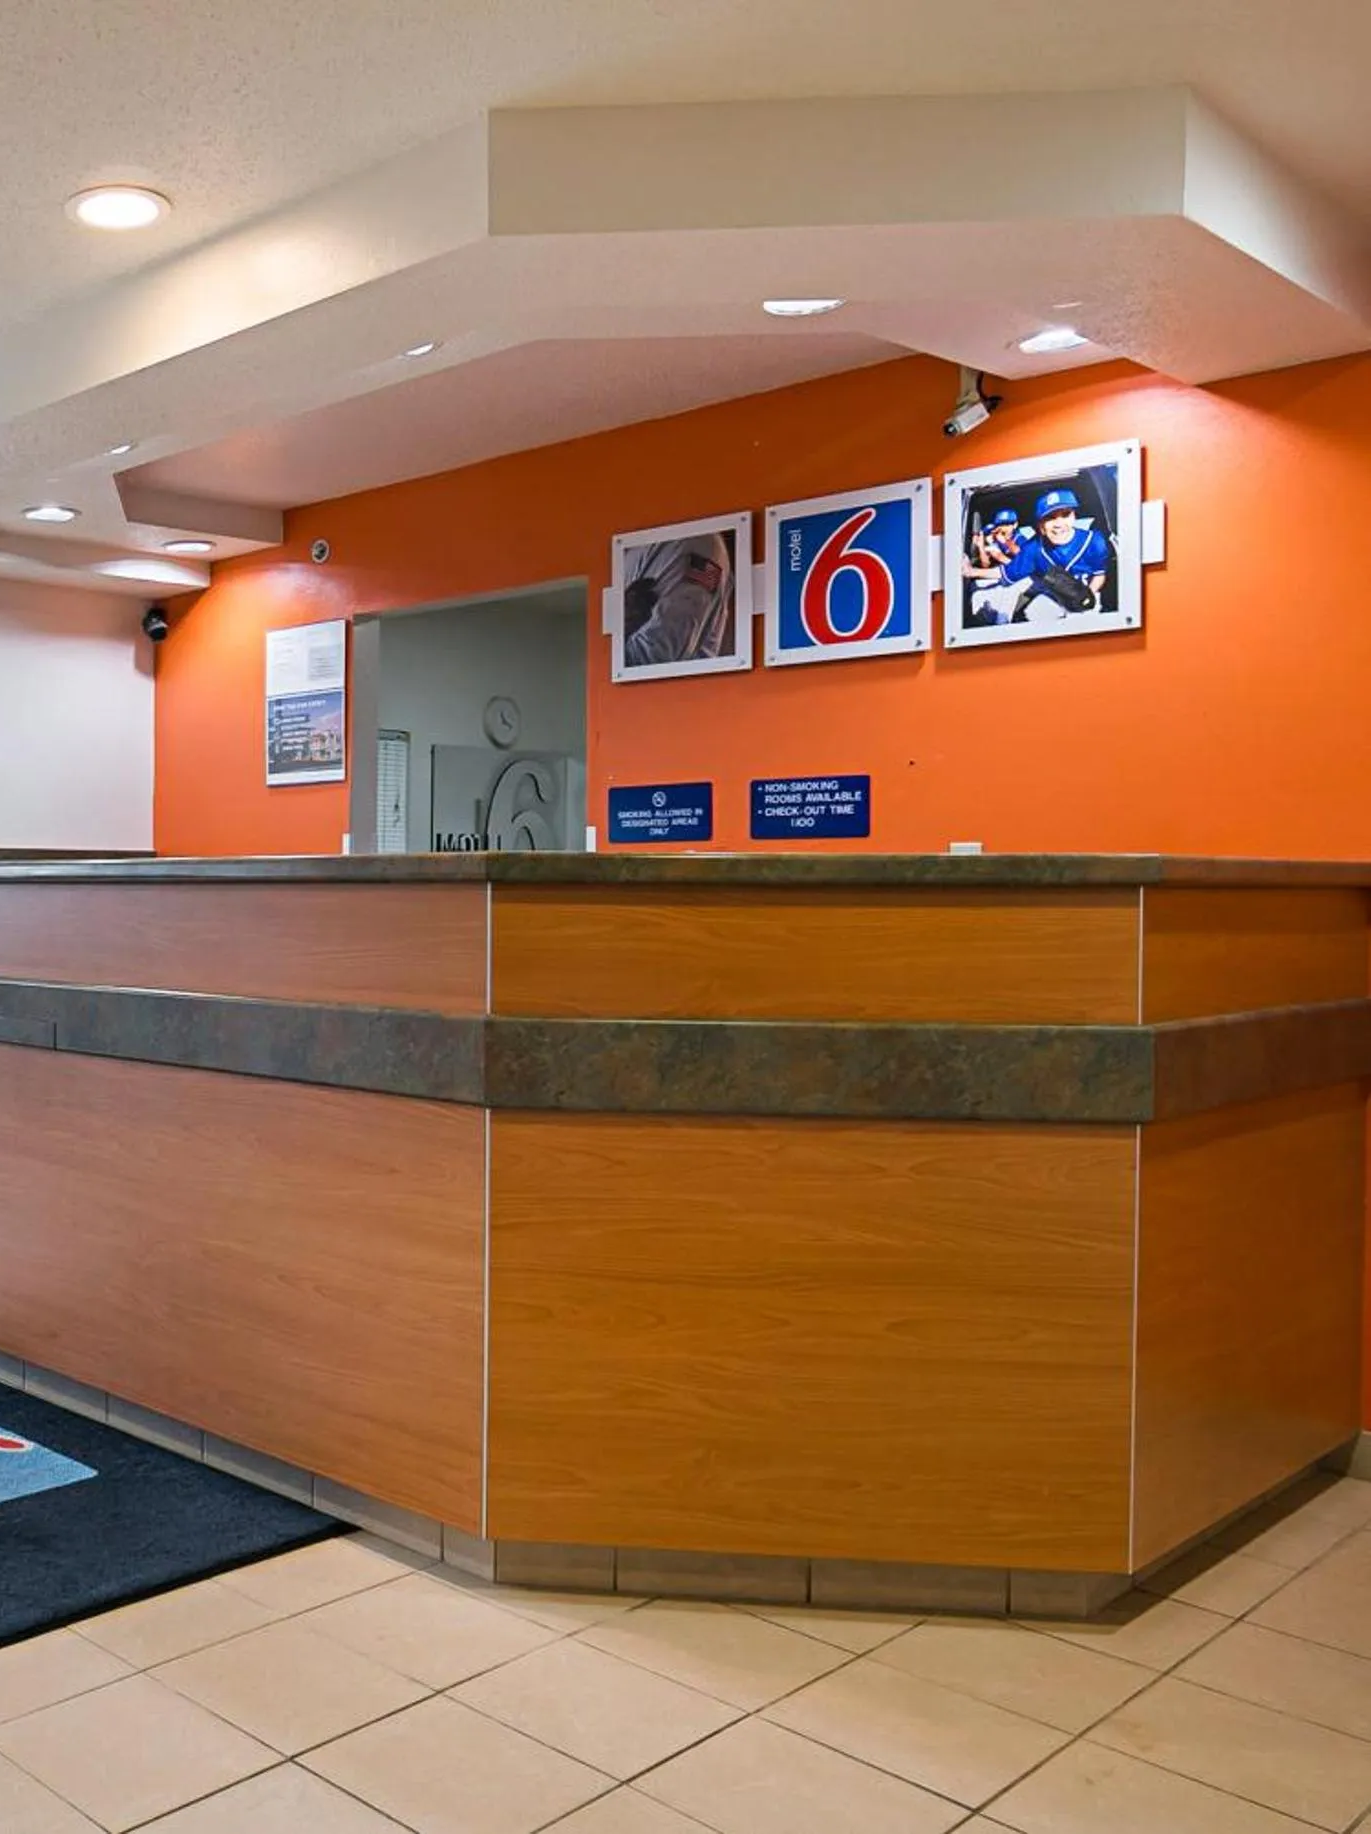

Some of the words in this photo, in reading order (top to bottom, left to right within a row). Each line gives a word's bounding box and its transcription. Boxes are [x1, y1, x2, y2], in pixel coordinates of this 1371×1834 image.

[788, 529, 802, 572] motel
[800, 507, 895, 646] 6
[764, 780, 839, 793] NON-SMOKING
[764, 793, 802, 804] ROOMS
[805, 791, 862, 802] AVAILABLE
[617, 810, 653, 819] SMOKING
[654, 807, 692, 818] ALLOWED
[694, 807, 703, 816] IN
[829, 804, 855, 815] TIME
[621, 819, 669, 828] DESIGNATED
[671, 817, 699, 826] AREAS
[649, 827, 670, 836] ONLY
